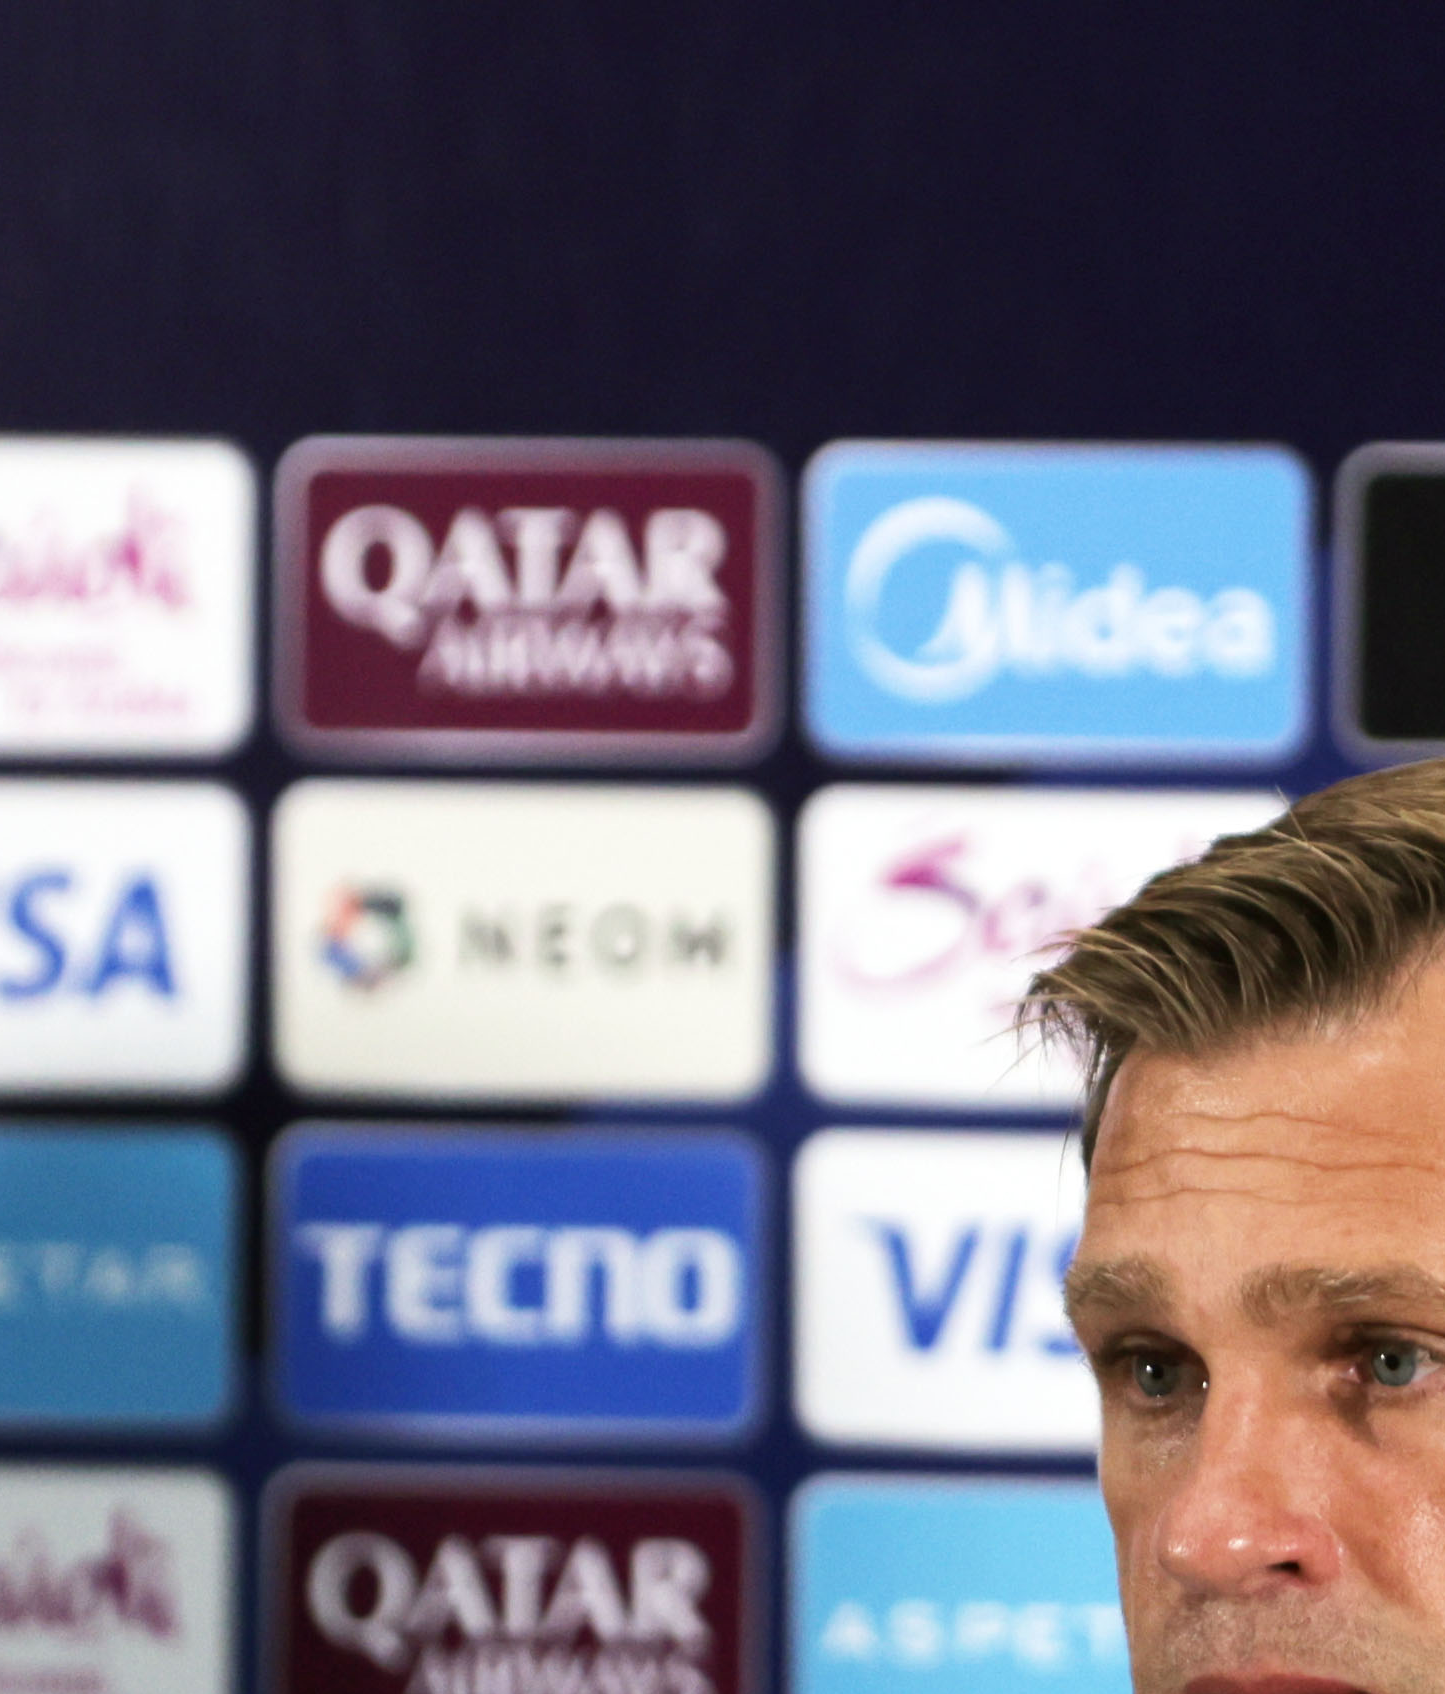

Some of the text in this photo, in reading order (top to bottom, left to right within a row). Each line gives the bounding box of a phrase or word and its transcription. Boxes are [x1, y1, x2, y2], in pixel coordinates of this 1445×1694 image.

[319, 503, 727, 648] QATAR
[915, 558, 1275, 681] Midea
[459, 902, 736, 970] NEOM
[300, 1222, 738, 1349] TECNO
[863, 1214, 1083, 1358] VI
[305, 1532, 710, 1671] QATAR
